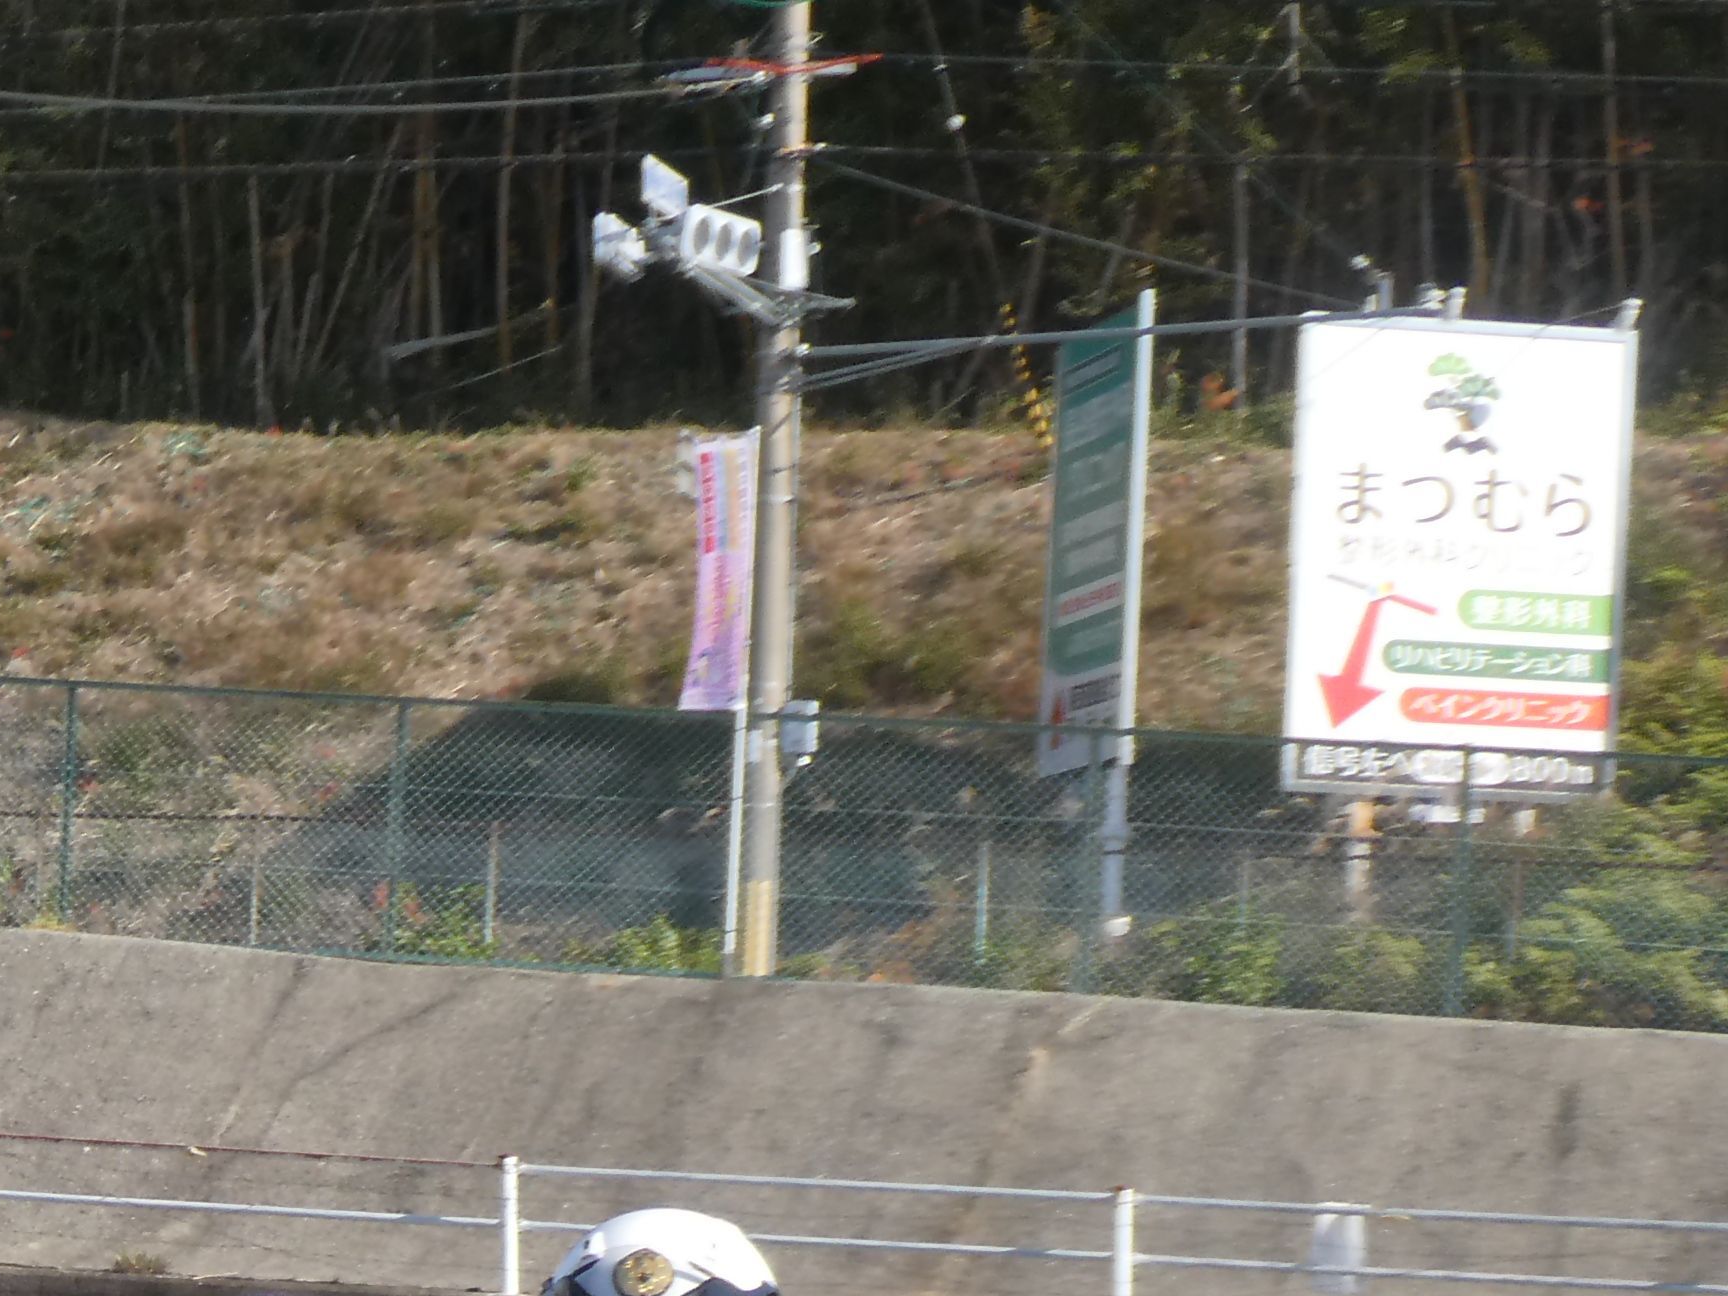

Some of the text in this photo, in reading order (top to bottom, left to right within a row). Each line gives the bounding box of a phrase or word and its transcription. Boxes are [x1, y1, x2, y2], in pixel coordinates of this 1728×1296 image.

[1337, 463, 1592, 537] まつむら
[1471, 594, 1593, 630] 整形外科
[1390, 644, 1593, 678] リハビリテーション科
[1410, 693, 1593, 724] ペインクリニック
